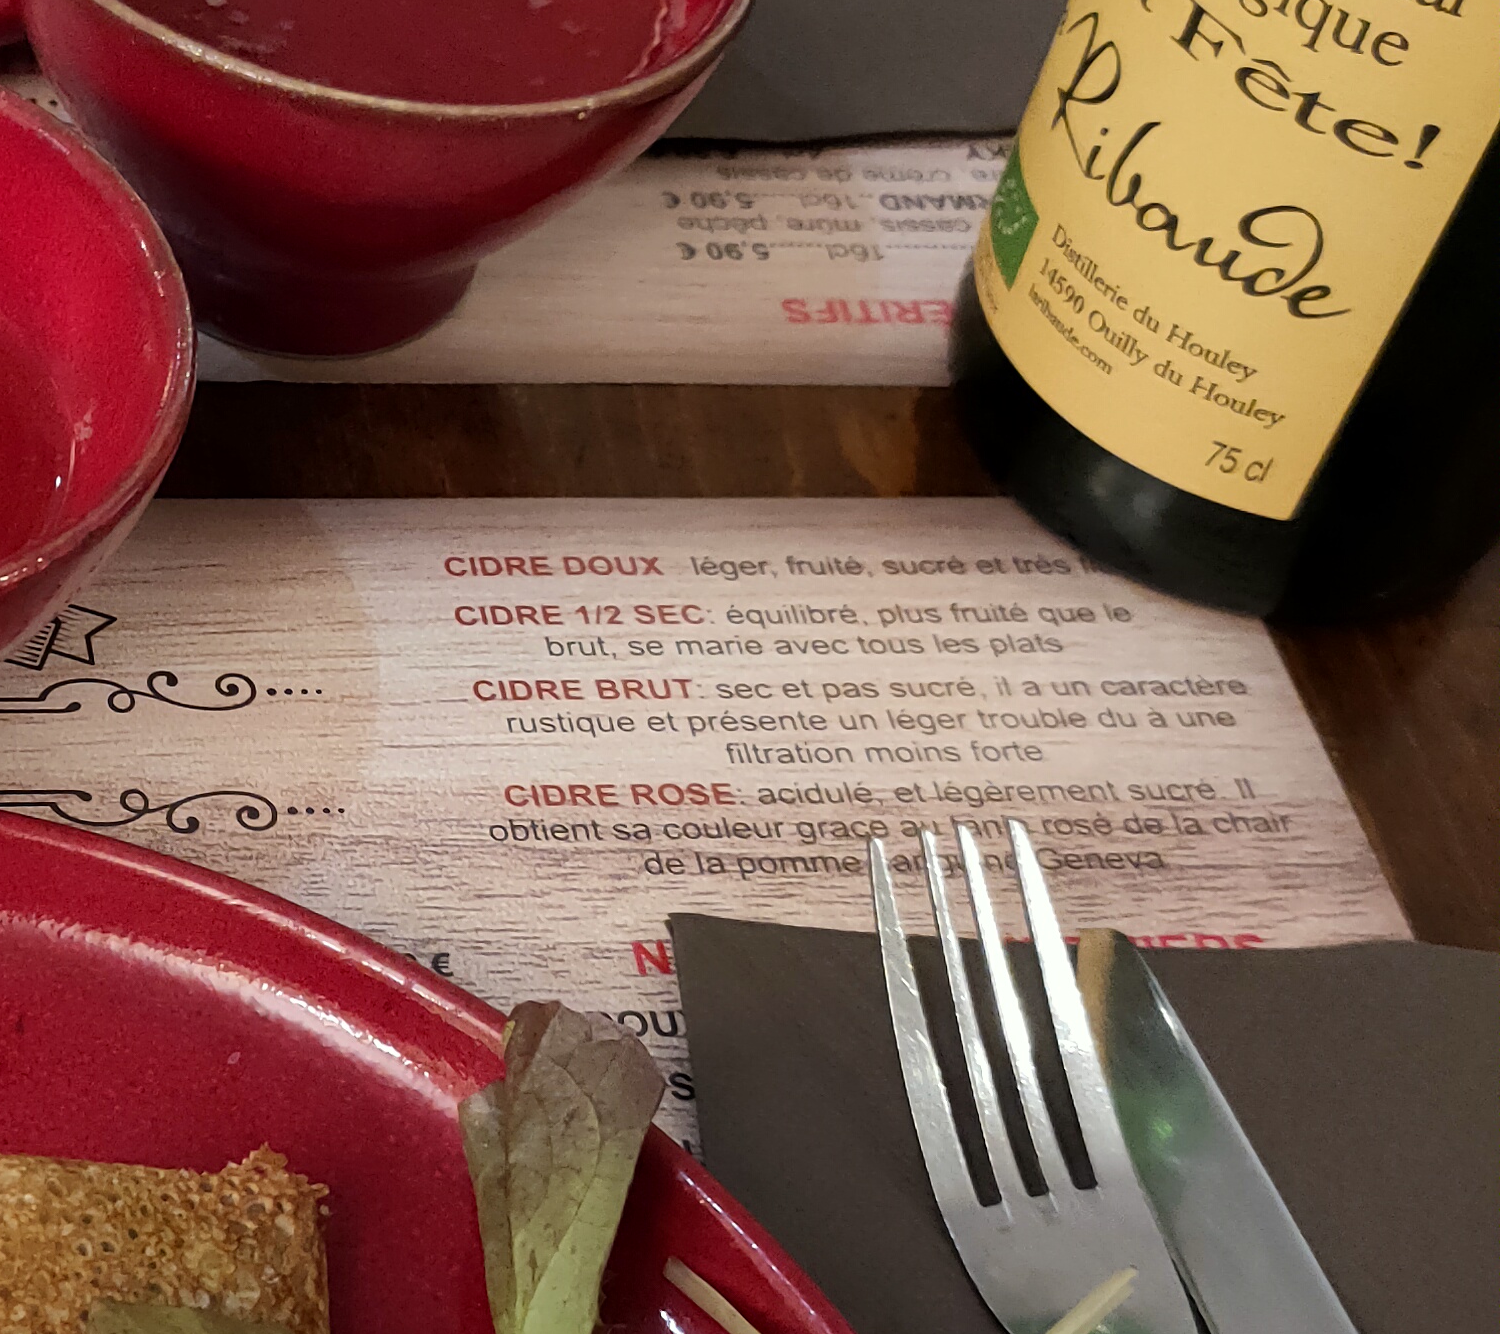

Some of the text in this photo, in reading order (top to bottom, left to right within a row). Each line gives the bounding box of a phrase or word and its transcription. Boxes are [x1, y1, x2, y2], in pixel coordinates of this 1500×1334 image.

[1051, 11, 1352, 319] Ribaude
[1051, 223, 1129, 311] Distillerie
[1133, 305, 1160, 333] du
[1165, 324, 1258, 383] Houley
[1038, 258, 1085, 315] 14590
[1088, 310, 1149, 367] Ouilly
[1154, 360, 1183, 387] du
[1188, 375, 1286, 429] Houley
[1204, 440, 1274, 485] 75 cl
[444, 555, 553, 577] CIDRE
[562, 555, 665, 577] DOUX
[691, 555, 778, 581] léger,
[882, 555, 966, 576] sucré
[977, 556, 1002, 575] et
[1011, 555, 1072, 576] très
[454, 603, 1134, 629] CIDRE 1/2 SEC: équilibré, plus fruité que le
[545, 634, 1065, 659] brut, se marie avec tous les plats
[473, 675, 1248, 703] CIDRE BRUT: sec et pas sucré, il a un caractère
[506, 706, 1238, 738] rustique et présente un léger trouble du à une
[726, 740, 1044, 765] filtration moins forte
[503, 784, 620, 808] CIDRE
[757, 782, 884, 805] acidulé,
[894, 783, 924, 802] et
[932, 781, 1121, 808] légèrement
[489, 818, 603, 842] obtient
[613, 823, 652, 842] sa
[663, 817, 784, 841] couleur
[795, 819, 890, 844] grace
[1042, 813, 1113, 836] rosé
[1123, 814, 1164, 835] de
[1172, 813, 1203, 835] la
[1211, 811, 1294, 835] chair
[644, 852, 686, 875] de
[698, 851, 726, 875] la
[736, 854, 861, 880] pomme
[1035, 848, 1165, 871] Geneva
